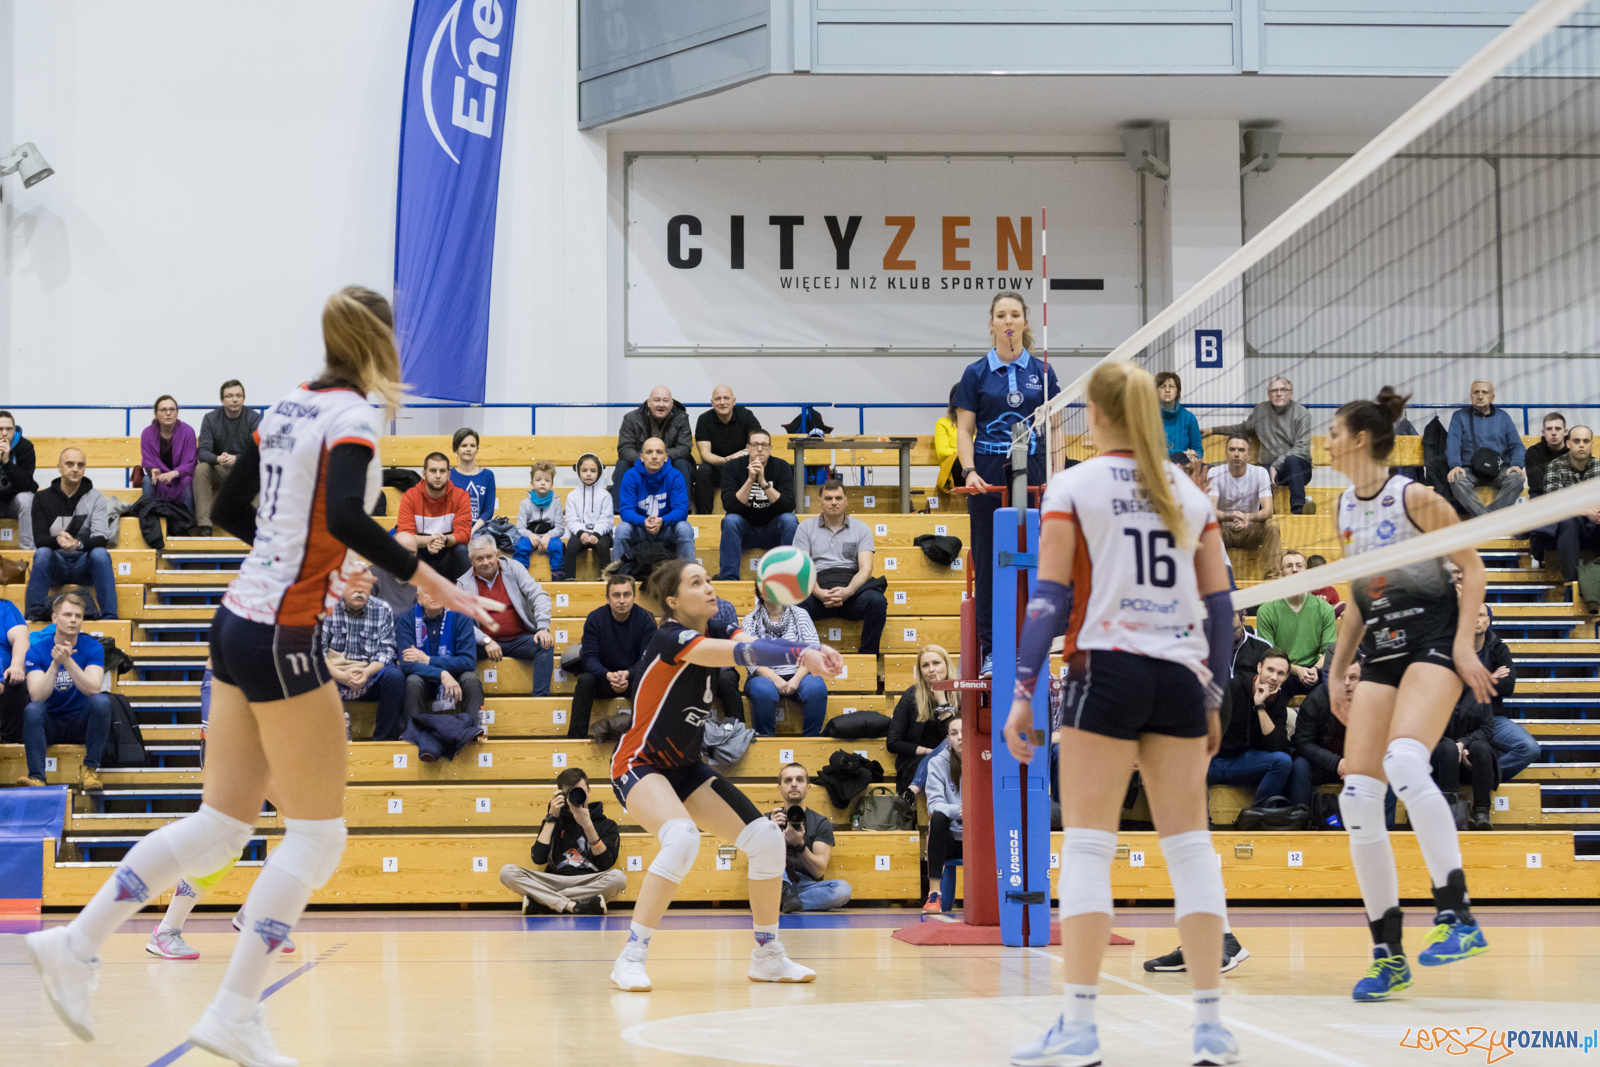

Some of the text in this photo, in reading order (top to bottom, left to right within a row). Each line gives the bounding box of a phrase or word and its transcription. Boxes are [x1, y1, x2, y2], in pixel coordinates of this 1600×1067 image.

[667, 214, 1033, 271] CITYZEN
[780, 275, 1034, 293] WIĘCEJ NIŻ KLUB SPORTOWY
[1200, 335, 1218, 362] B
[258, 464, 283, 521] 11
[1123, 527, 1177, 589] 16
[285, 652, 310, 676] 11
[959, 681, 987, 689] Senoh
[632, 858, 638, 866] 4
[1133, 854, 1142, 862] 14
